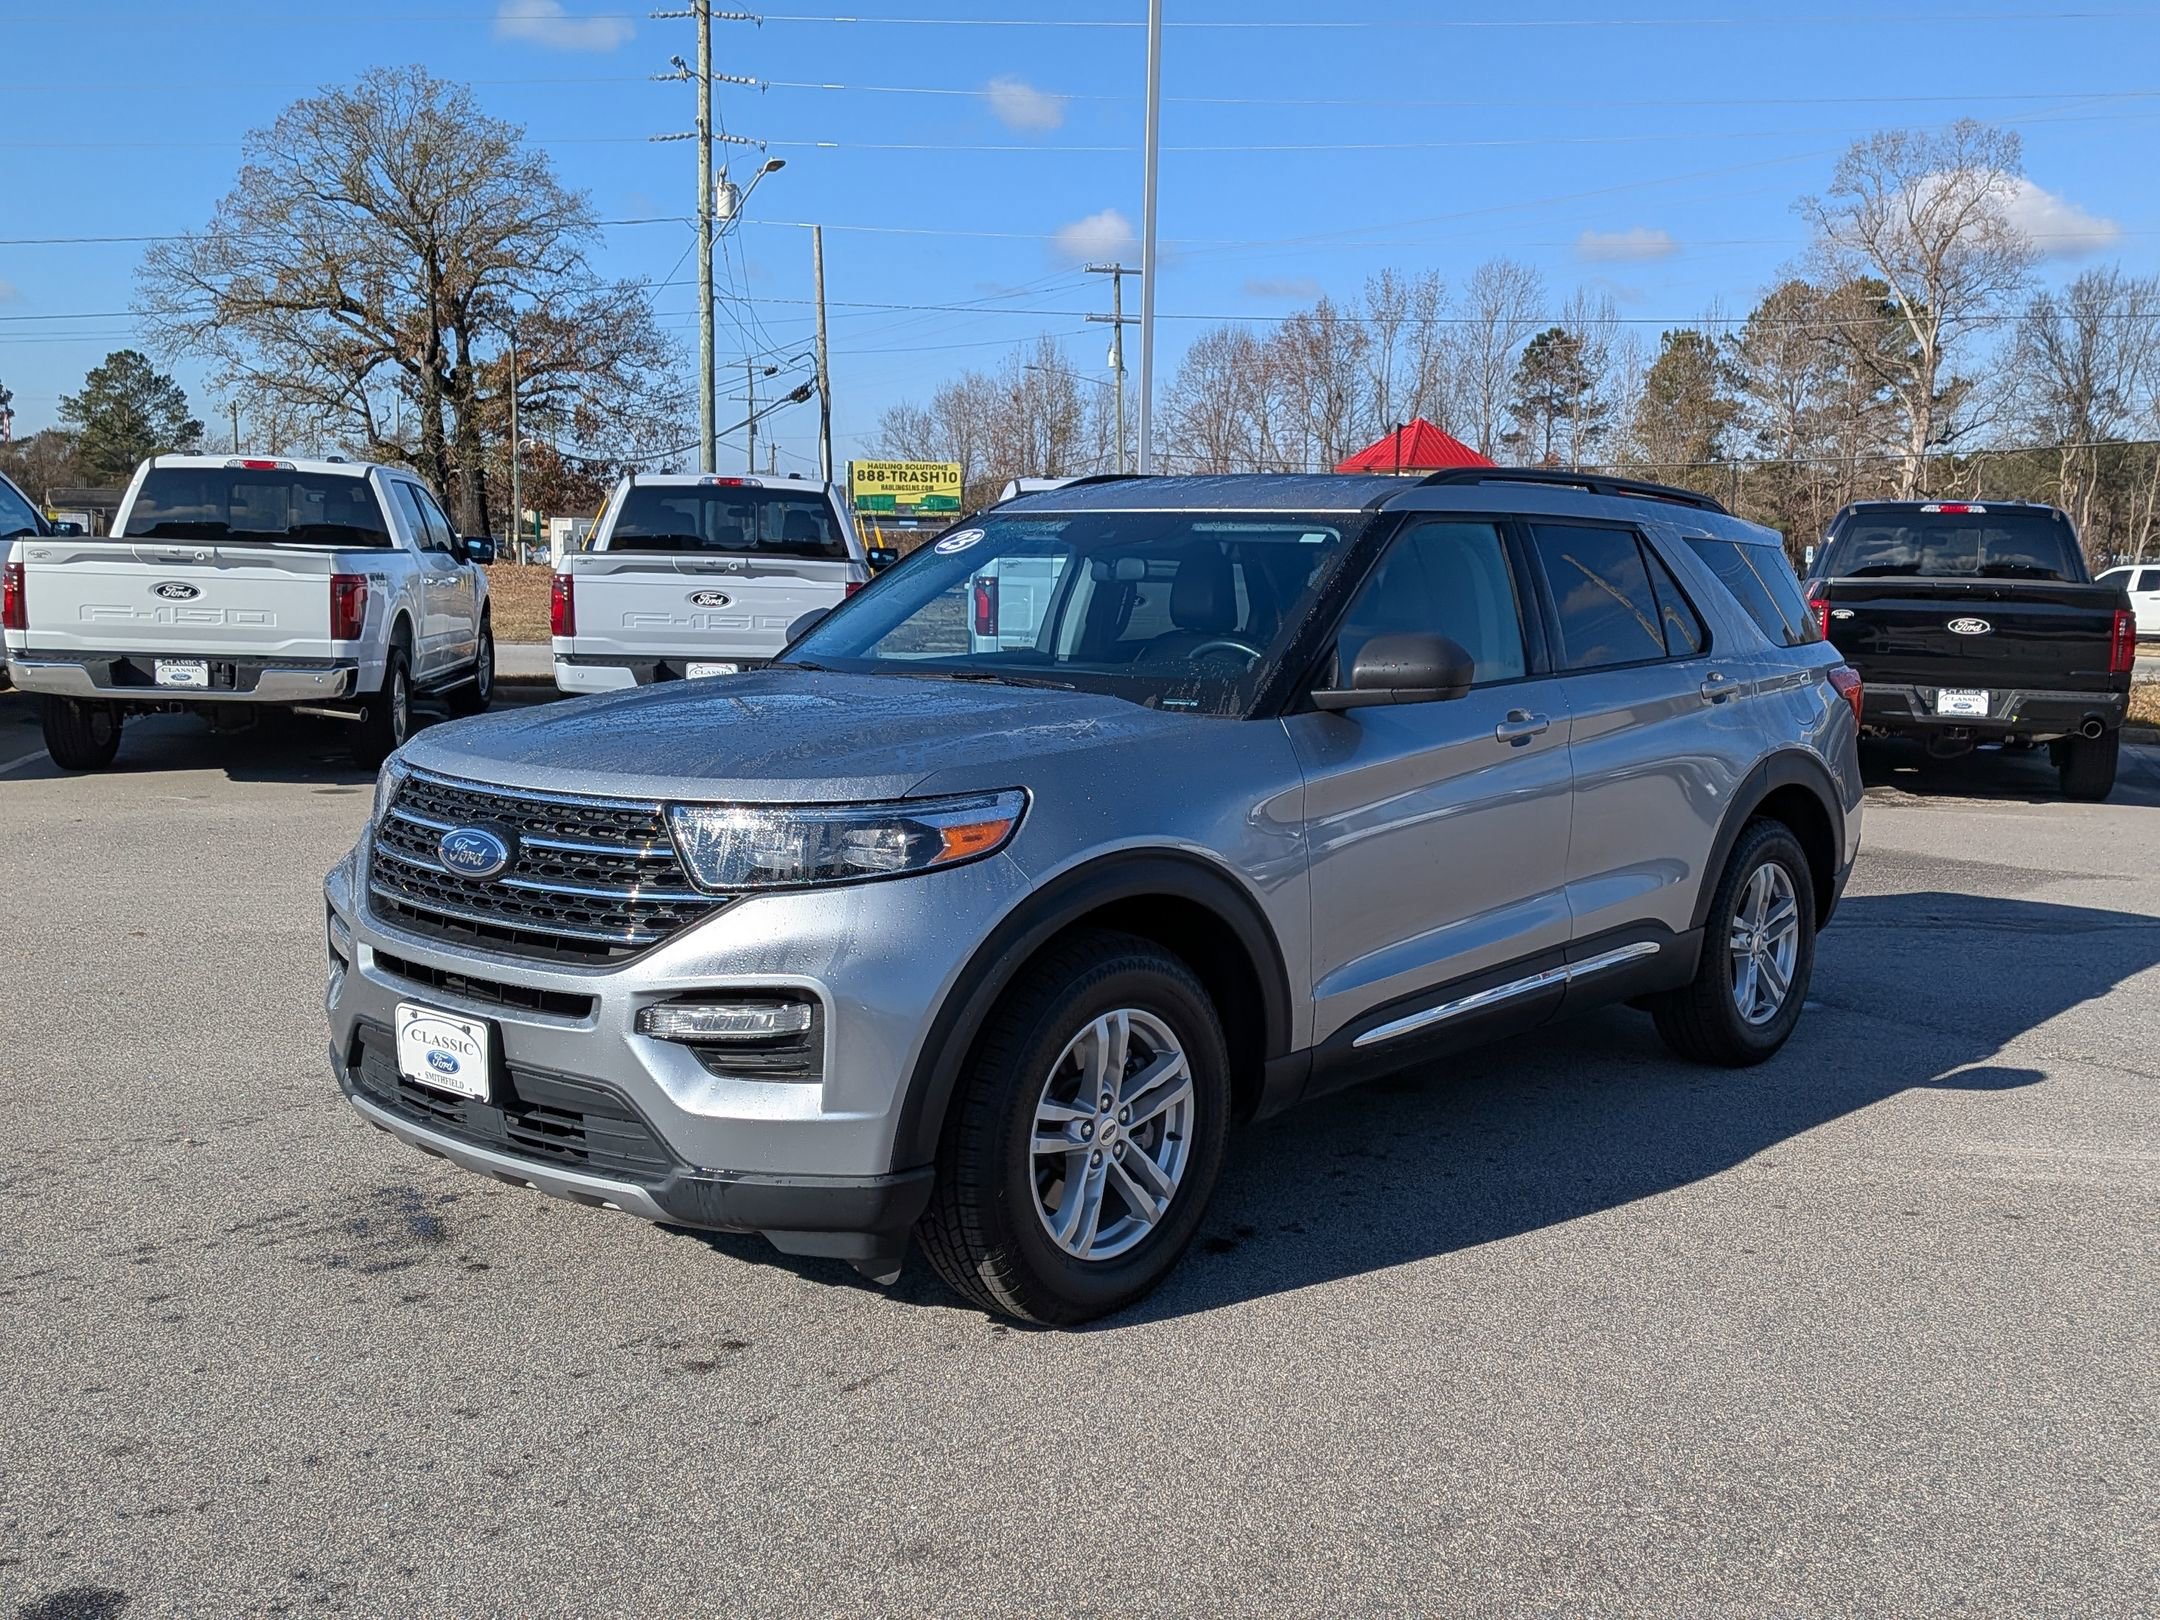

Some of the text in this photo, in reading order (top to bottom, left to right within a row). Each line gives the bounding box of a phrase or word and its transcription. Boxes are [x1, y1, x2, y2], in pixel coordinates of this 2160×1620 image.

[857, 470, 958, 483] 888-TRASH10
[905, 463, 949, 471] SOLUTIONS
[162, 585, 191, 598] Ford
[698, 593, 723, 606] Ford
[80, 604, 277, 627] F-150
[622, 612, 792, 631] F-150
[1955, 620, 1983, 631] Ford
[449, 837, 488, 866] Ford
[411, 1028, 475, 1056] CLASSIC
[432, 1052, 454, 1071] Ford
[425, 1071, 465, 1090] SMITHFIELD
